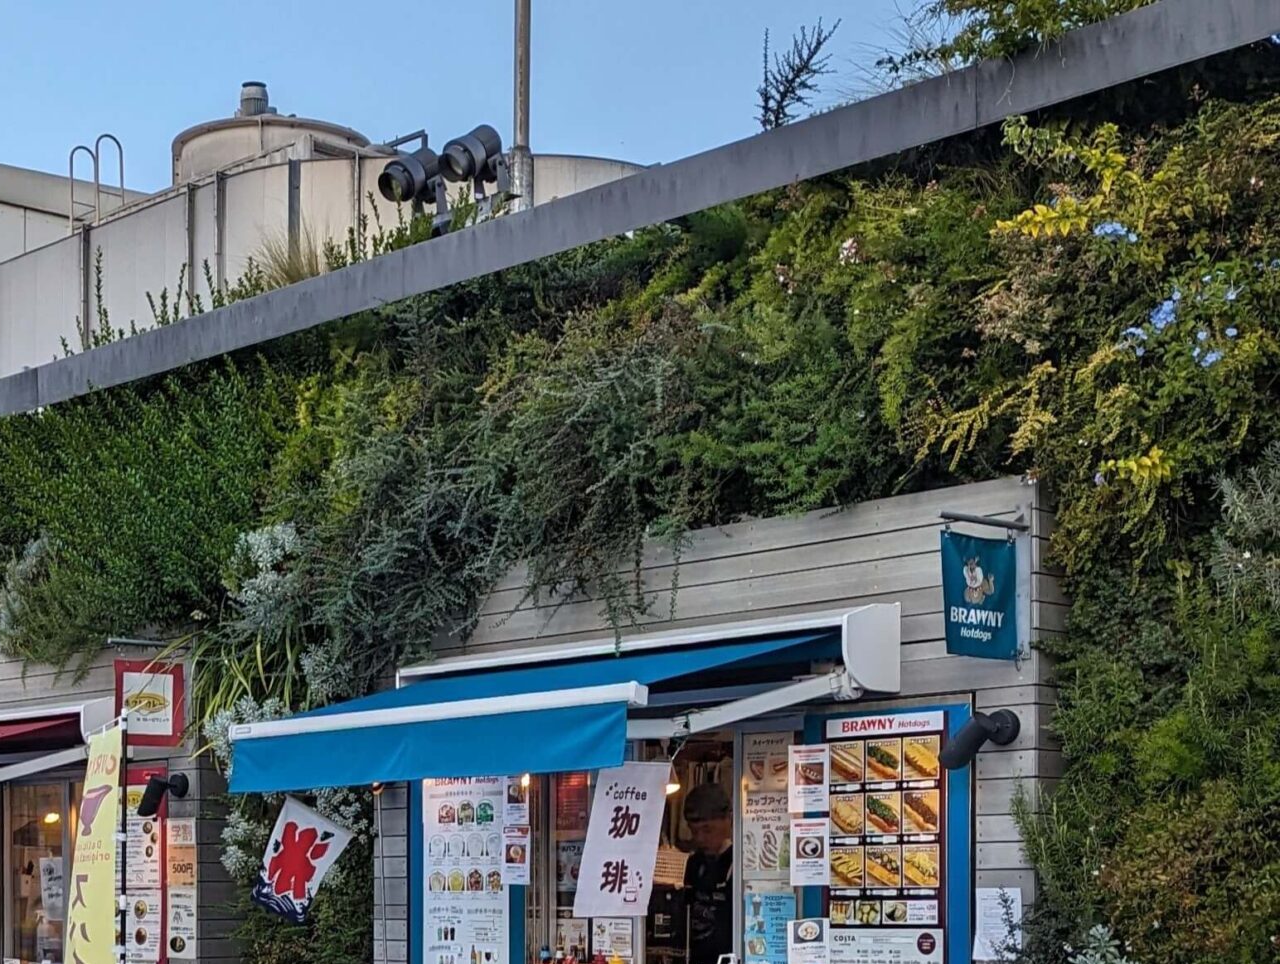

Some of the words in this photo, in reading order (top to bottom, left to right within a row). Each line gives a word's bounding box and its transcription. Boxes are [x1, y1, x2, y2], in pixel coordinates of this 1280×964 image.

[950, 606, 1005, 628] BRAWNY
[960, 627, 993, 641] Hotdogs
[841, 717, 895, 733] BRAWNY
[898, 718, 931, 730] Hotdogs
[613, 788, 648, 802] coffee
[172, 863, 194, 875] 500円
